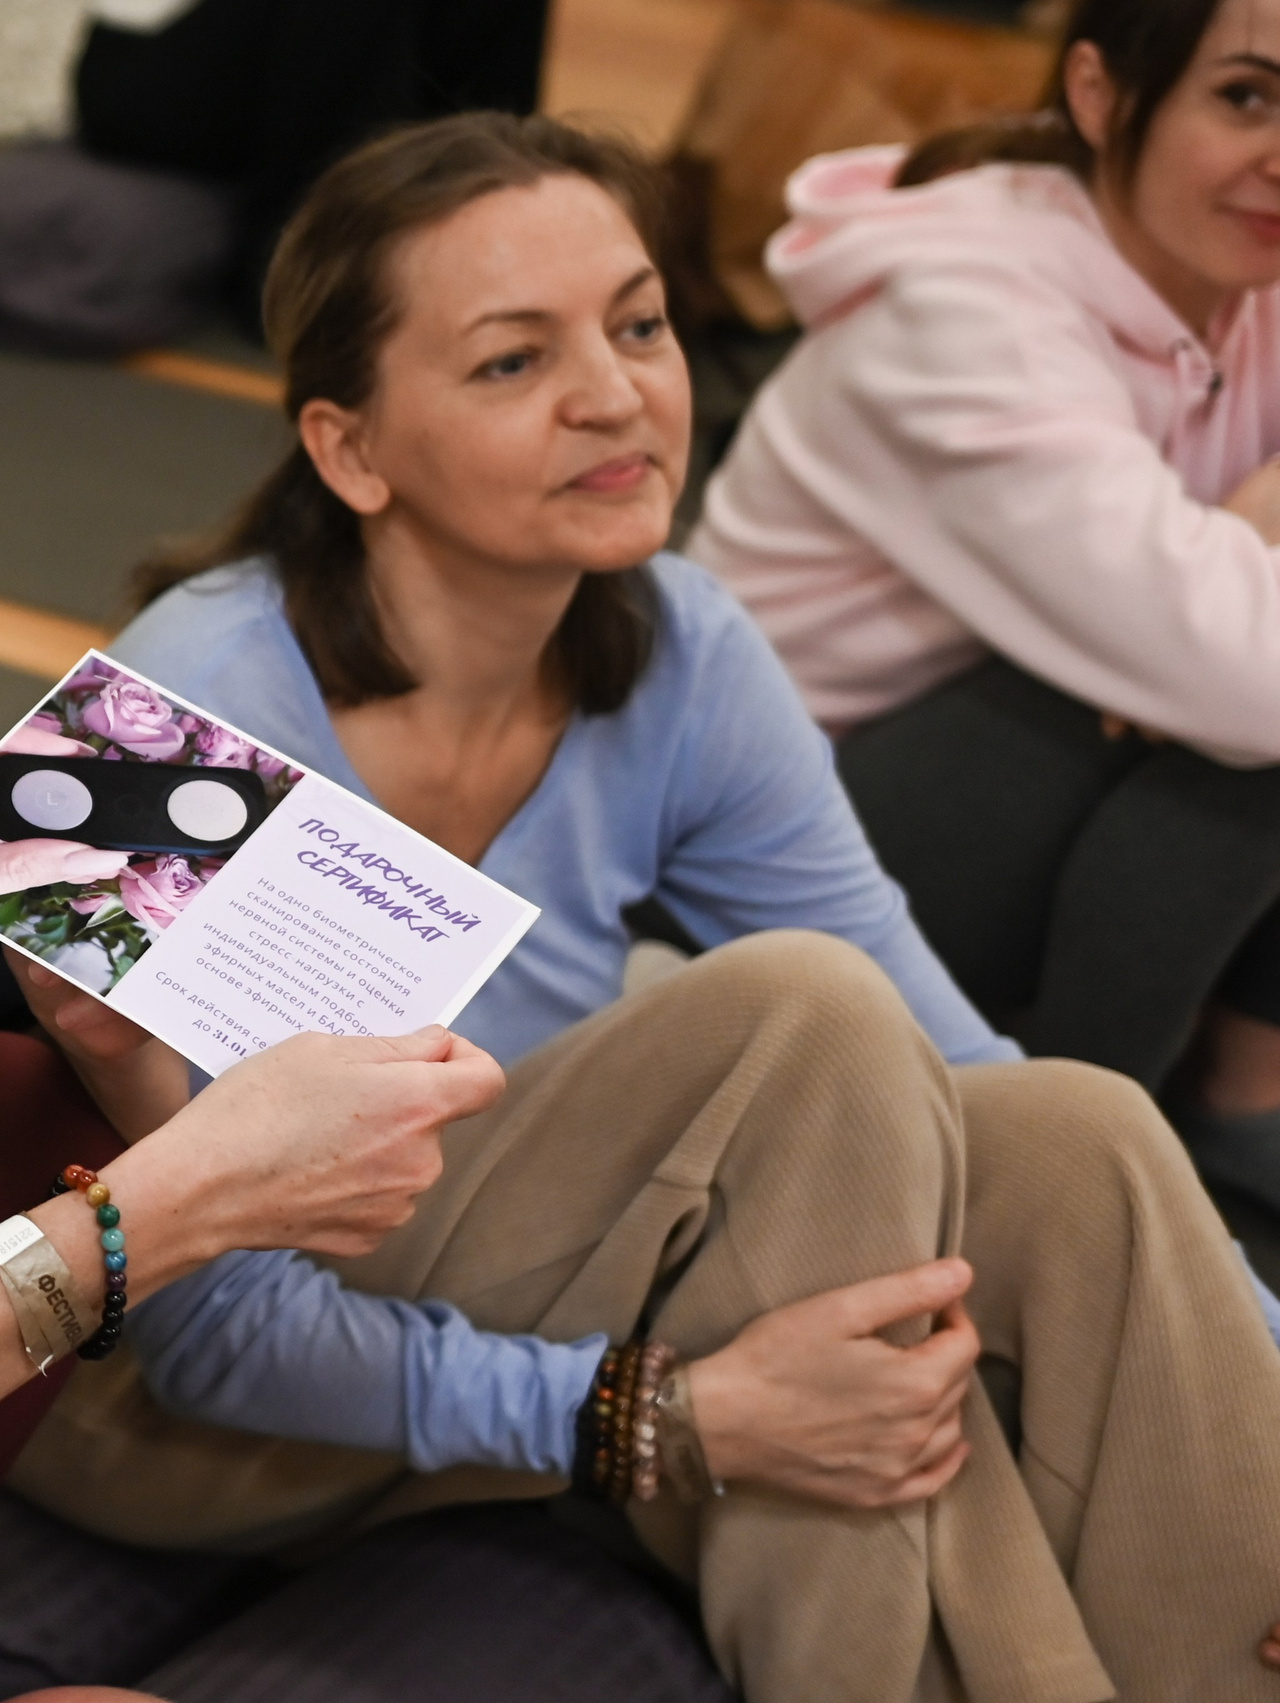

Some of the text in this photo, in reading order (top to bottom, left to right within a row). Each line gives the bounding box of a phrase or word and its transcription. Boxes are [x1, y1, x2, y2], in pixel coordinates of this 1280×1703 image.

[297, 851, 450, 942] СЕРТИФИКАТ
[298, 818, 482, 932] ПОДАРОЧНЫЙ
[203, 922, 319, 998] индивидуальным
[229, 899, 405, 1017] нервной системы и оценки
[247, 891, 412, 997] сканирование состояния
[257, 877, 423, 984] На одно биометрическое
[155, 971, 271, 1050] Срок действия се
[192, 1018, 211, 1032] до
[196, 957, 304, 1031] основе эфирных
[203, 942, 346, 1036] эфирных масел и БАД
[356, 999, 365, 1008] с
